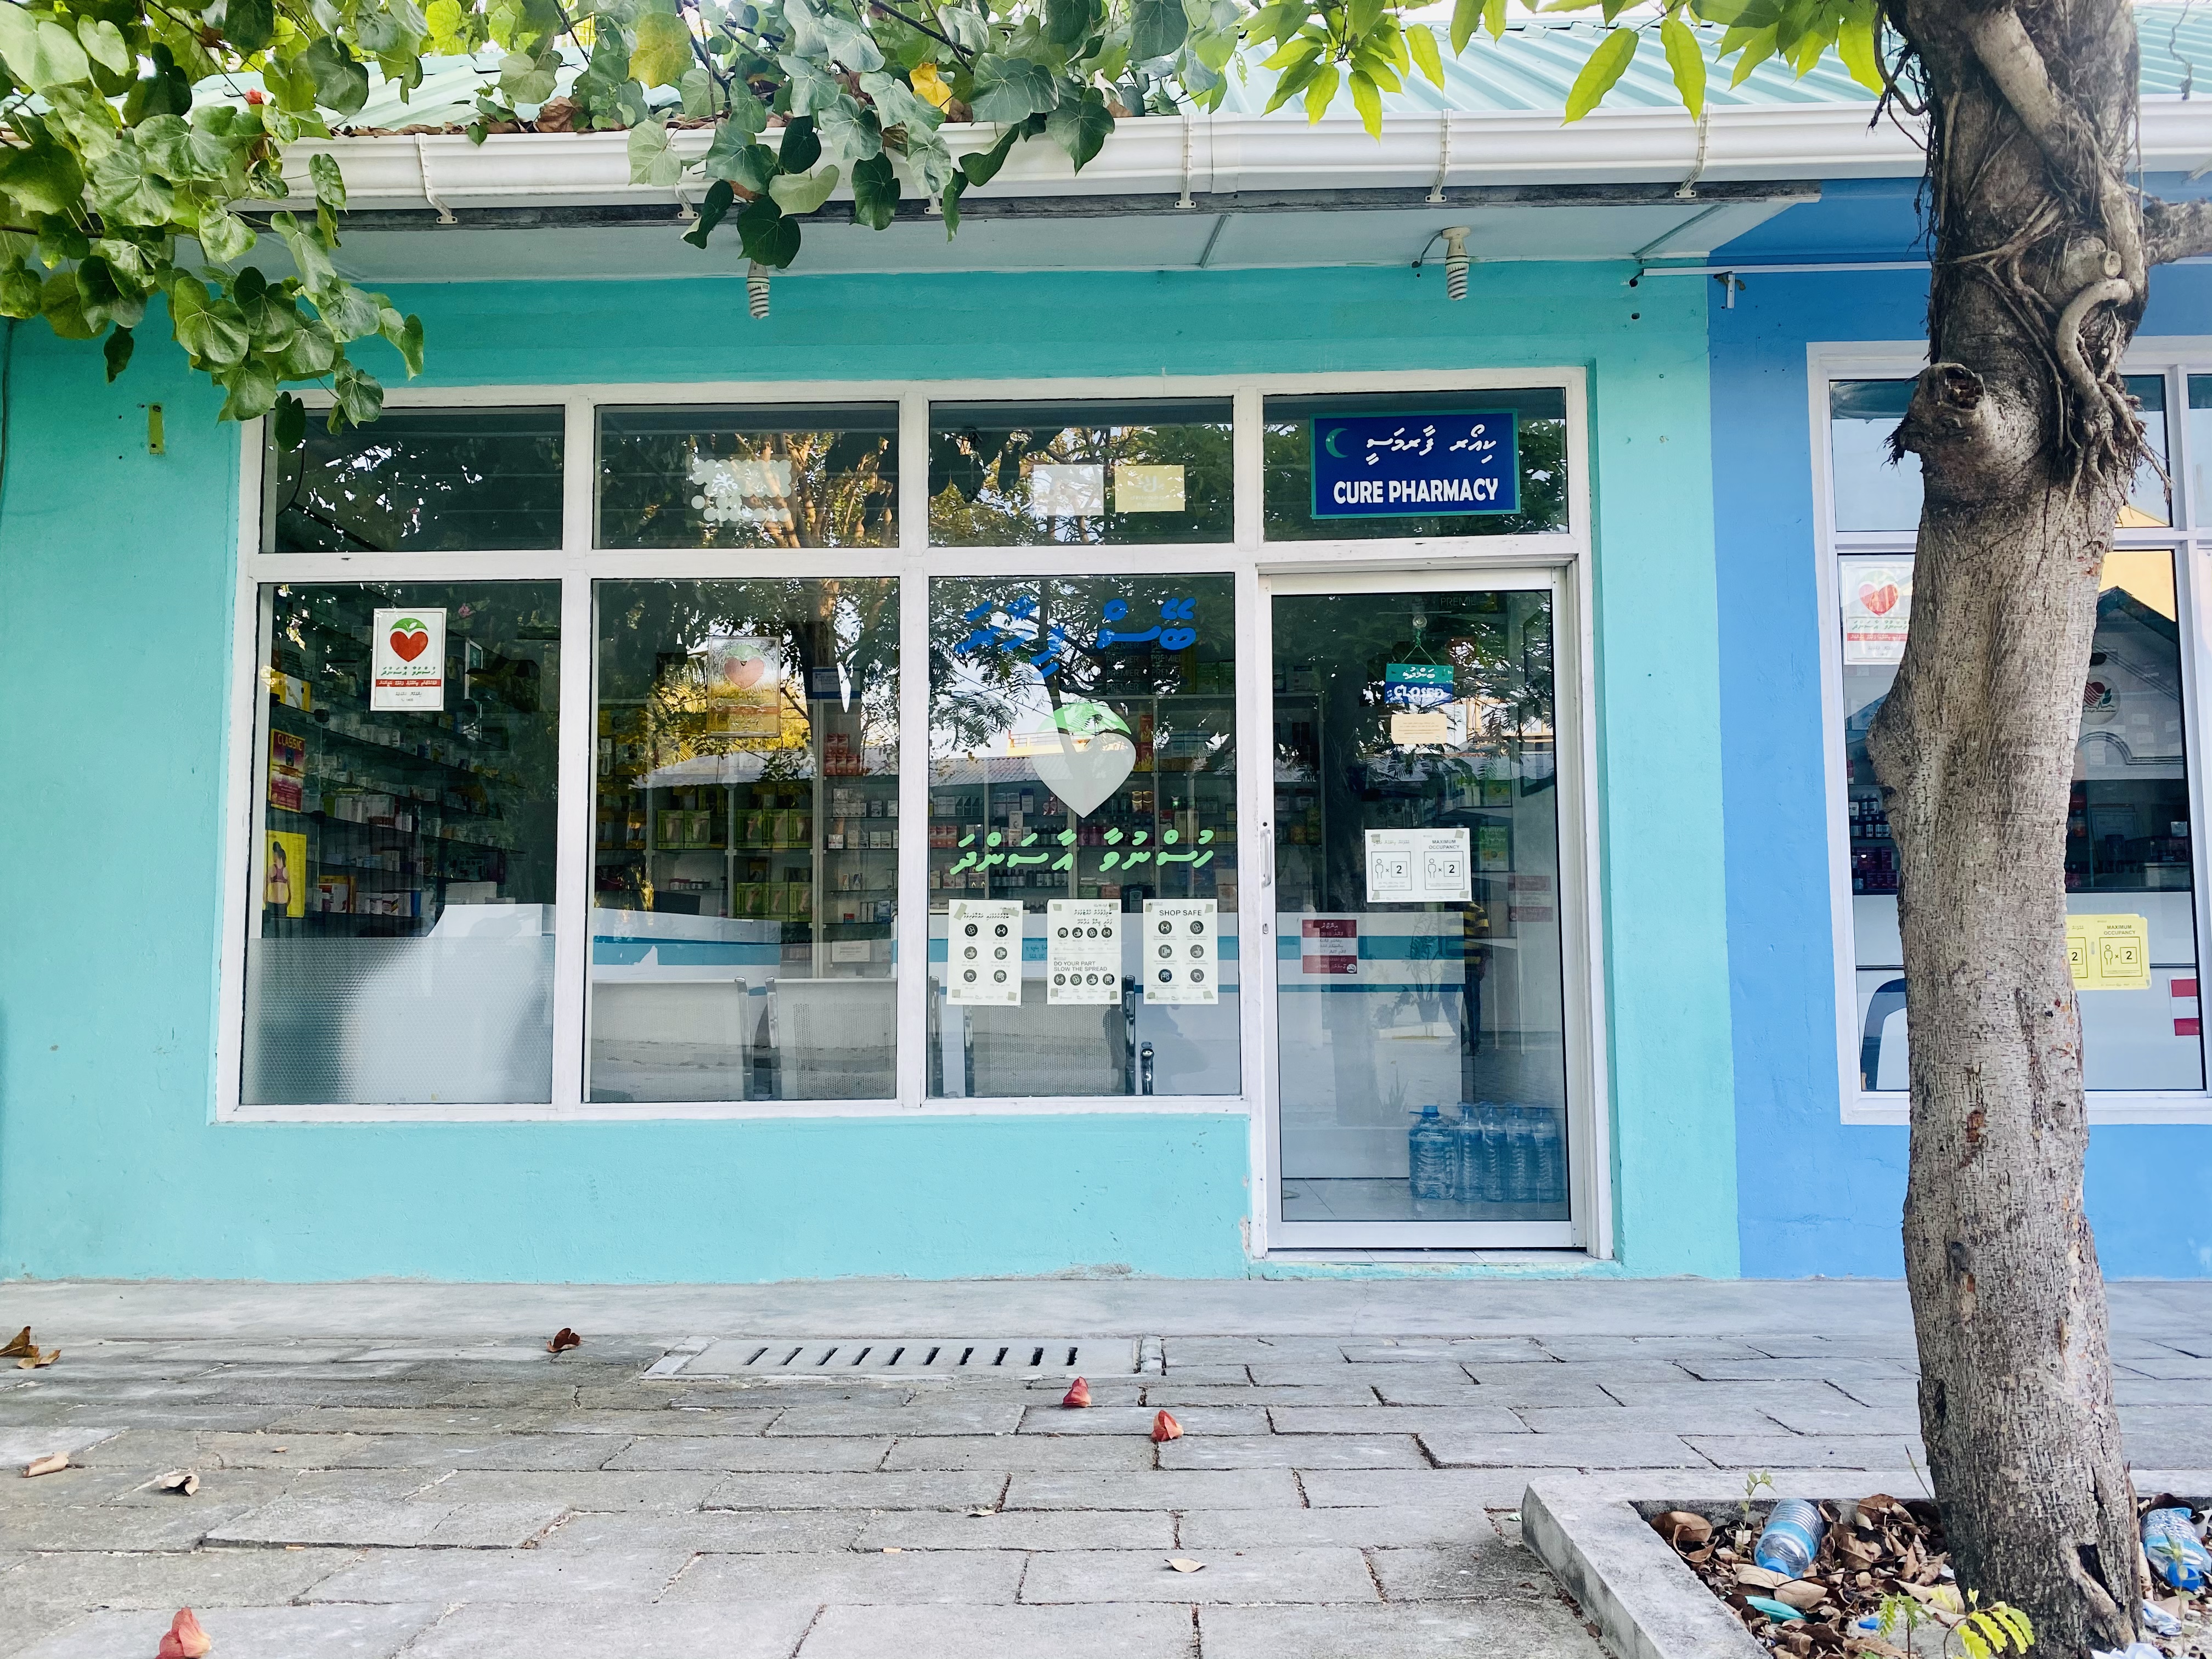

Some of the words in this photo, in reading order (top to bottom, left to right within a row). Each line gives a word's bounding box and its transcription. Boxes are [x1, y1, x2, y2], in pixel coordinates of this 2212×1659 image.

[1366, 425, 1436, 465] ފާރމަސީ
[1334, 481, 1384, 504] CURE
[1389, 478, 1498, 503] PHARMACY
[1097, 597, 1196, 650] ބޭސް
[1106, 682, 1139, 691] PREMIER
[1394, 685, 1444, 698] CLOSED
[278, 733, 302, 751] CLASSIC
[950, 828, 1077, 875] އާސަންދަ
[1099, 827, 1214, 872] ހުސްނުވާ
[1396, 865, 1402, 874] 2
[1449, 864, 1455, 873] 2
[2072, 952, 2078, 961] 2
[2126, 951, 2132, 960] 2
